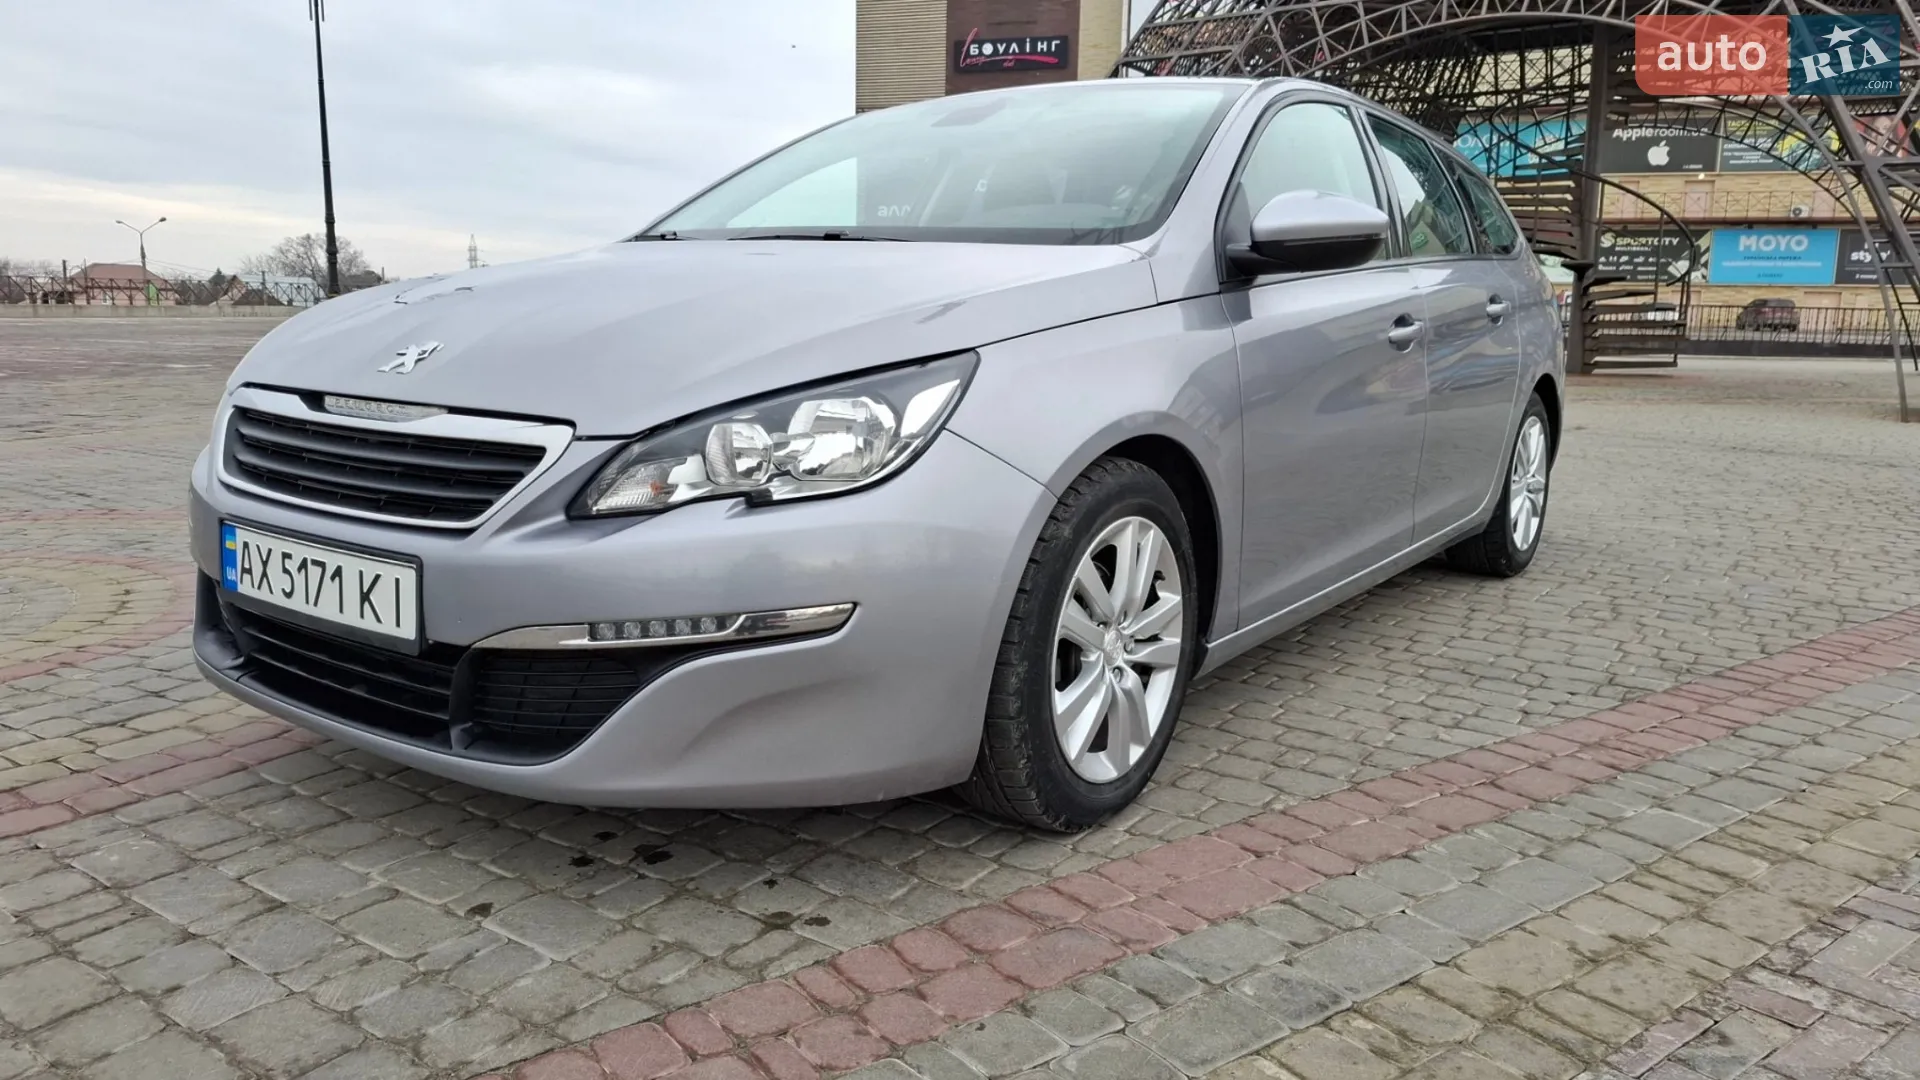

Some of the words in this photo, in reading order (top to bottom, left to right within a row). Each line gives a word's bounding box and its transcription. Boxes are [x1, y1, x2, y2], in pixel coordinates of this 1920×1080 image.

[969, 38, 1060, 56] БОУЛІНГ
[1739, 235, 1808, 252] MOYO
[226, 566, 237, 582] UA
[239, 540, 275, 595] AX
[281, 551, 344, 614] 5171
[358, 568, 401, 629] KI
